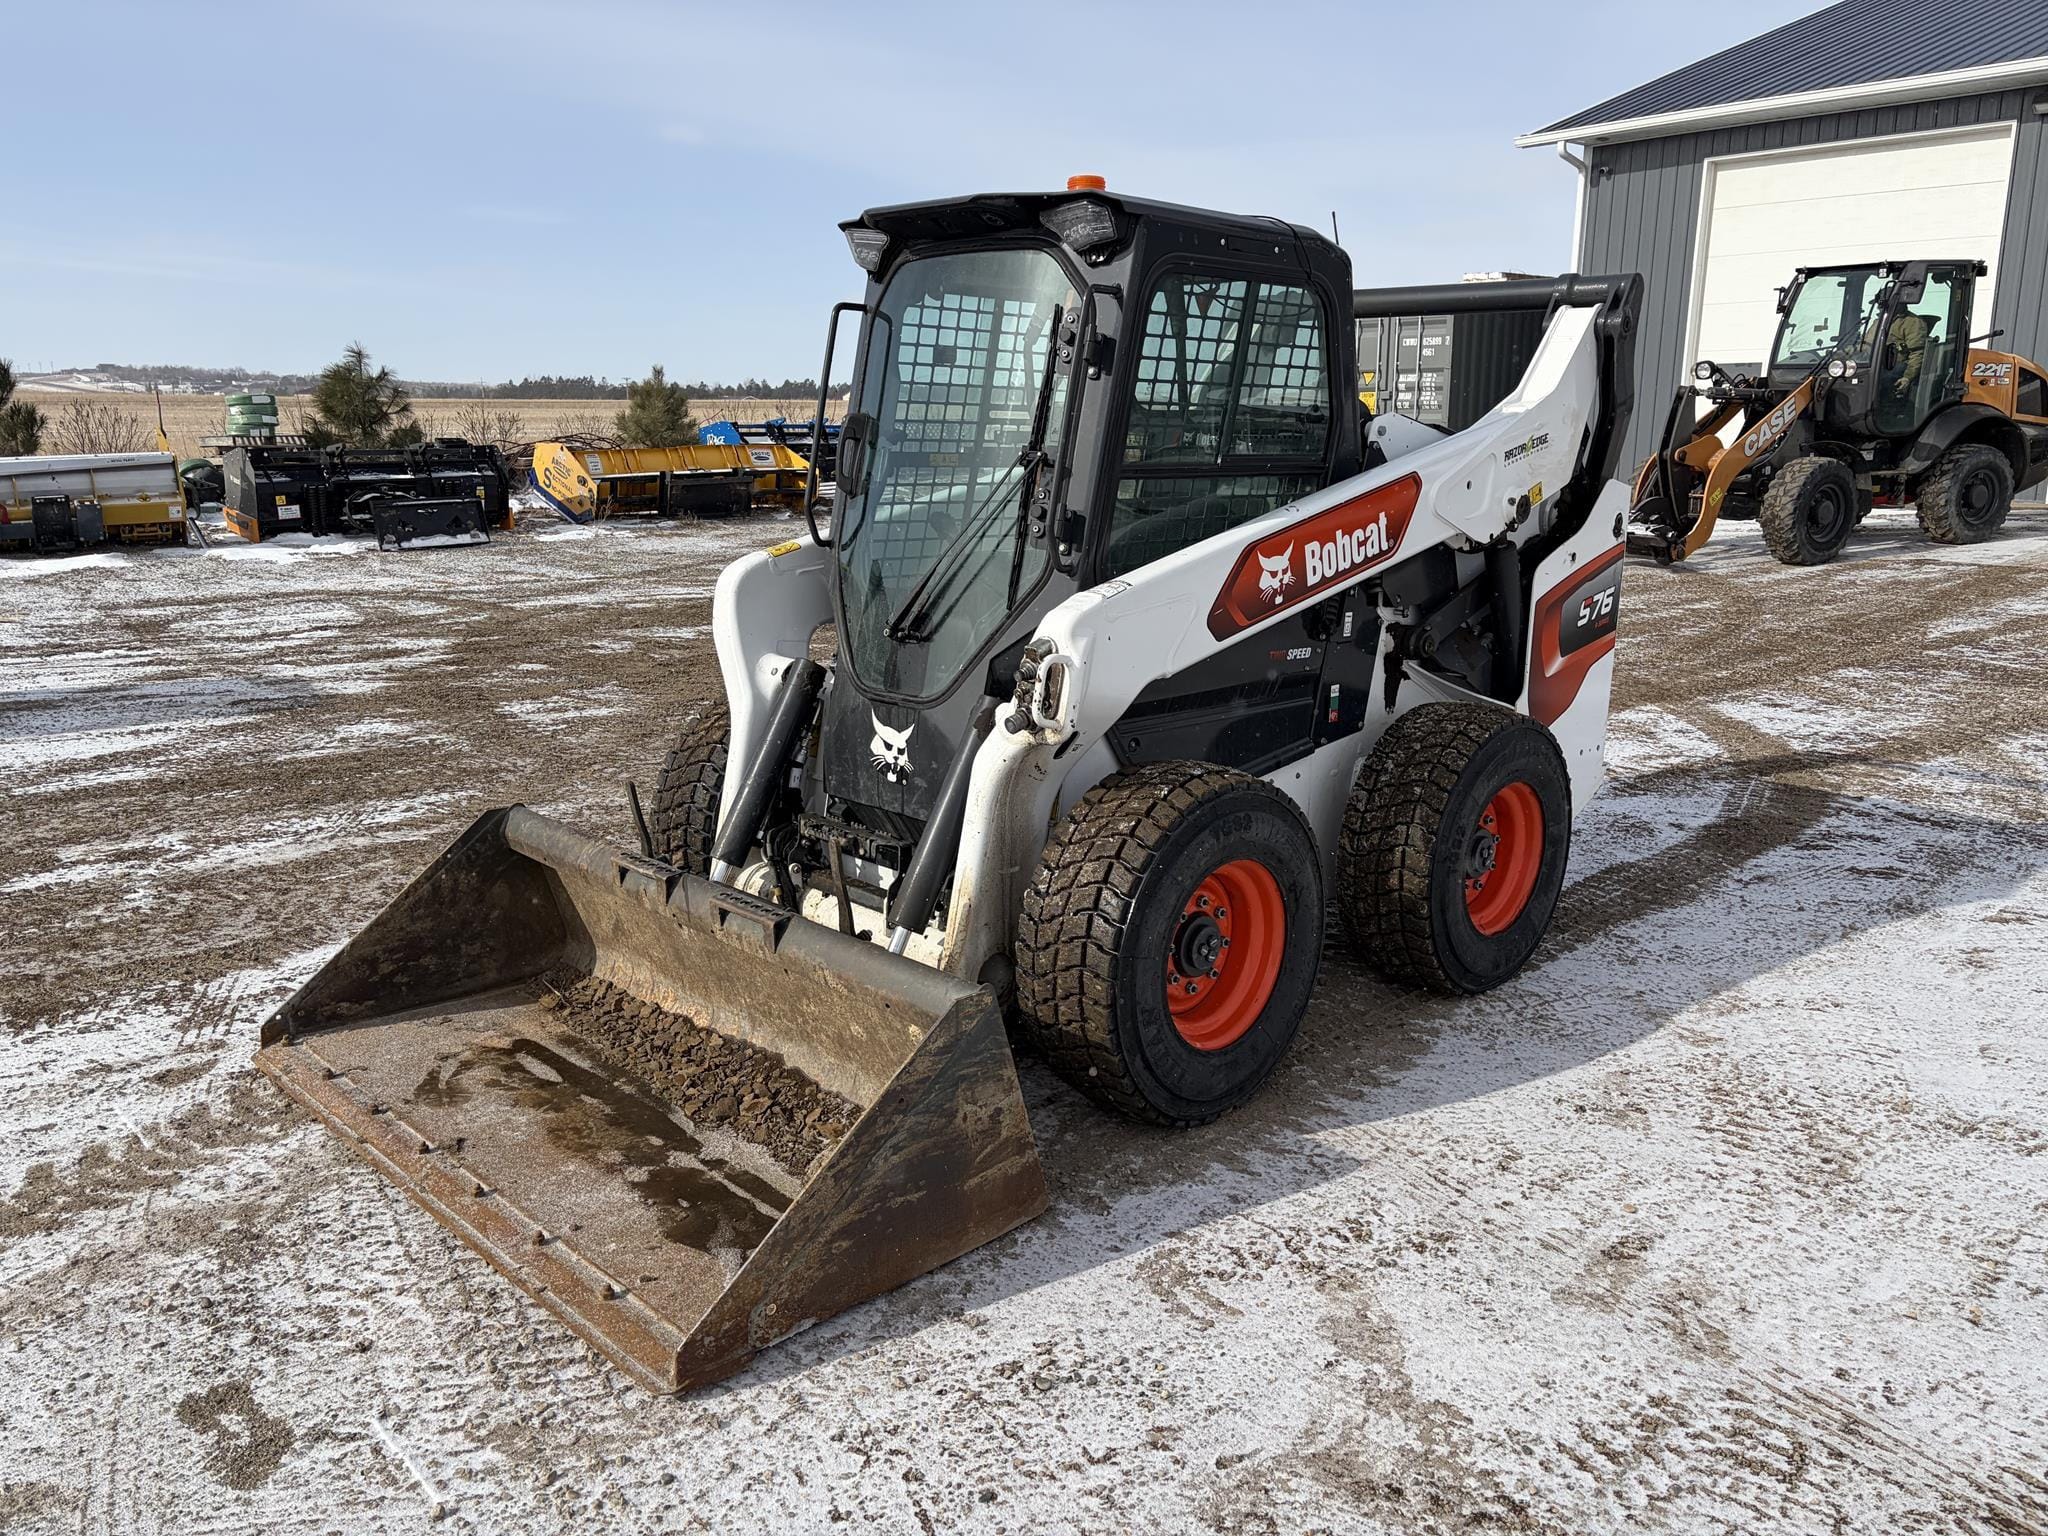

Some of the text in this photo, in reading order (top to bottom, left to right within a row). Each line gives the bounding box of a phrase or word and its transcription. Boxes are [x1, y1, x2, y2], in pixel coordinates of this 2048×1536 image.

[1971, 362, 2012, 377] 221F
[1531, 432, 1549, 450] EDGE
[1744, 396, 1796, 457] CASE
[1304, 511, 1389, 587] Bobcat
[1577, 585, 1616, 628] S76
[1286, 647, 1312, 660] SPEED
